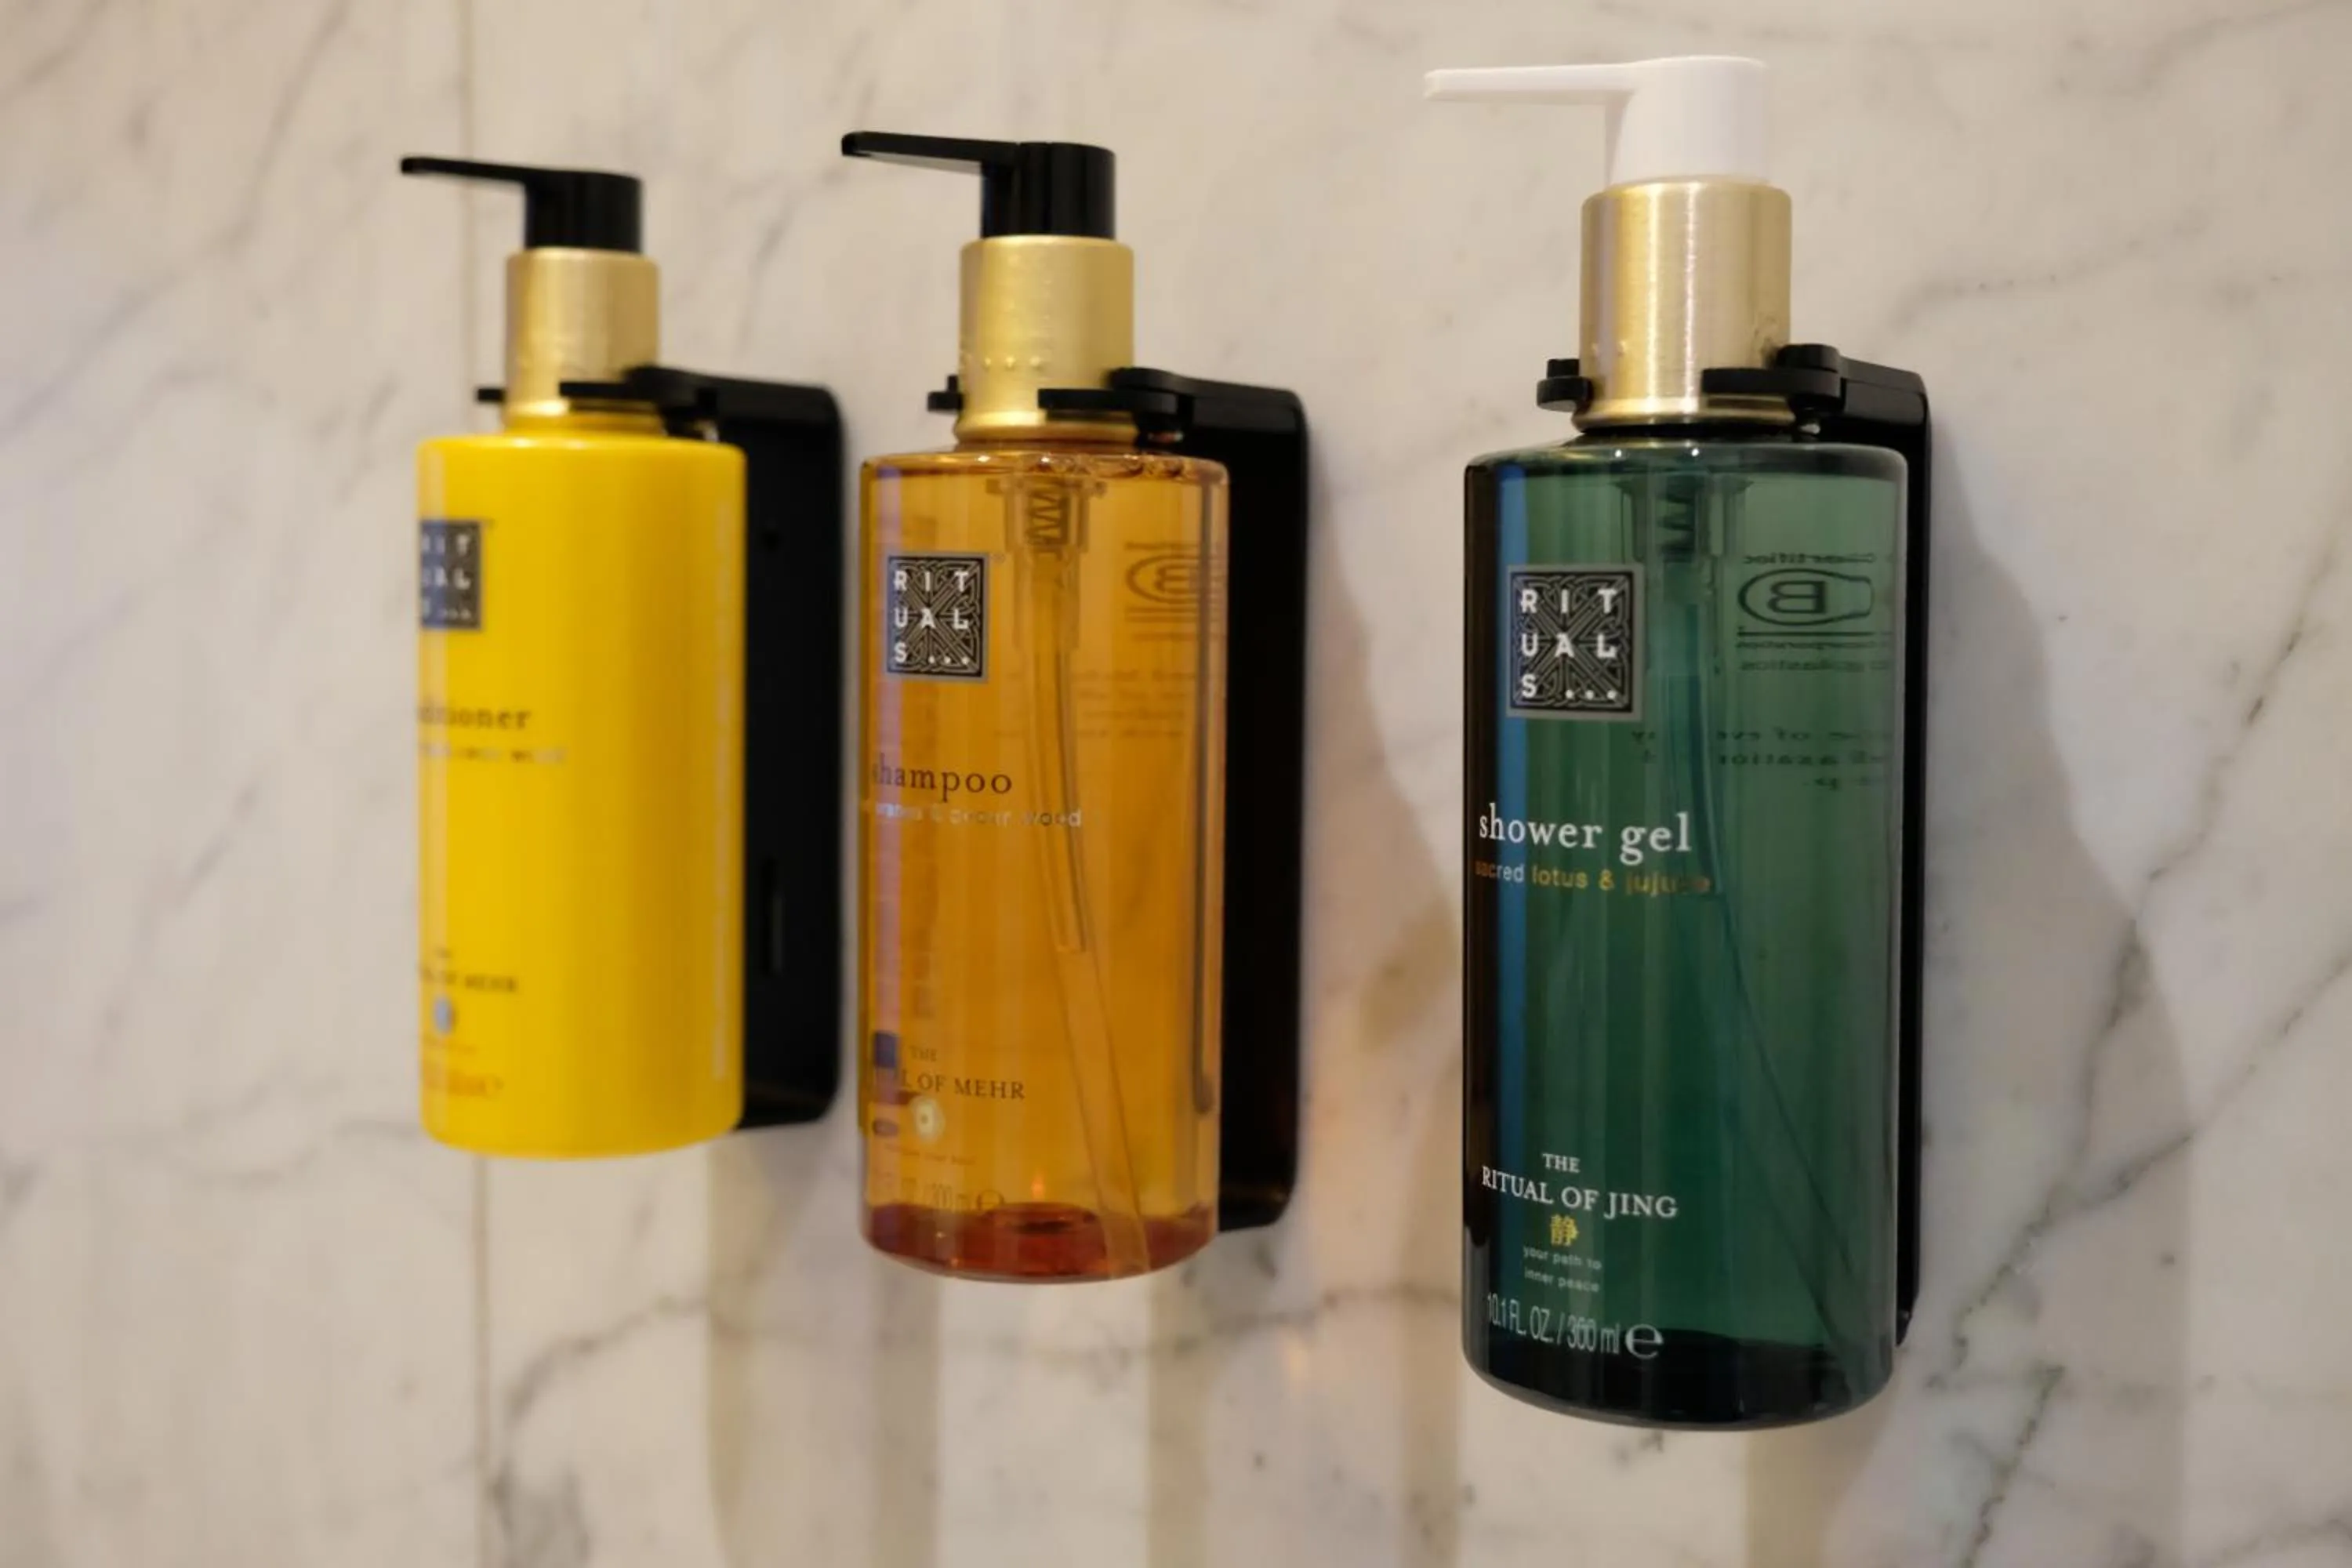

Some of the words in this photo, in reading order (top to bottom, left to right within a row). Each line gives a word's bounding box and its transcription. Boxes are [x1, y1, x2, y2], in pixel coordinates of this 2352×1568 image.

[1479, 802, 1602, 849] shower
[1619, 812, 1692, 866] gel
[1475, 860, 1525, 884] sacred
[1531, 865, 1588, 889] lotus
[1598, 869, 1615, 891] &
[916, 1072, 946, 1093] OF
[954, 1077, 1026, 1100] MEHR
[1542, 1152, 1581, 1174] THE
[1481, 1165, 1554, 1205] RITUAL
[1561, 1186, 1600, 1211] OF
[1603, 1191, 1679, 1220] JING
